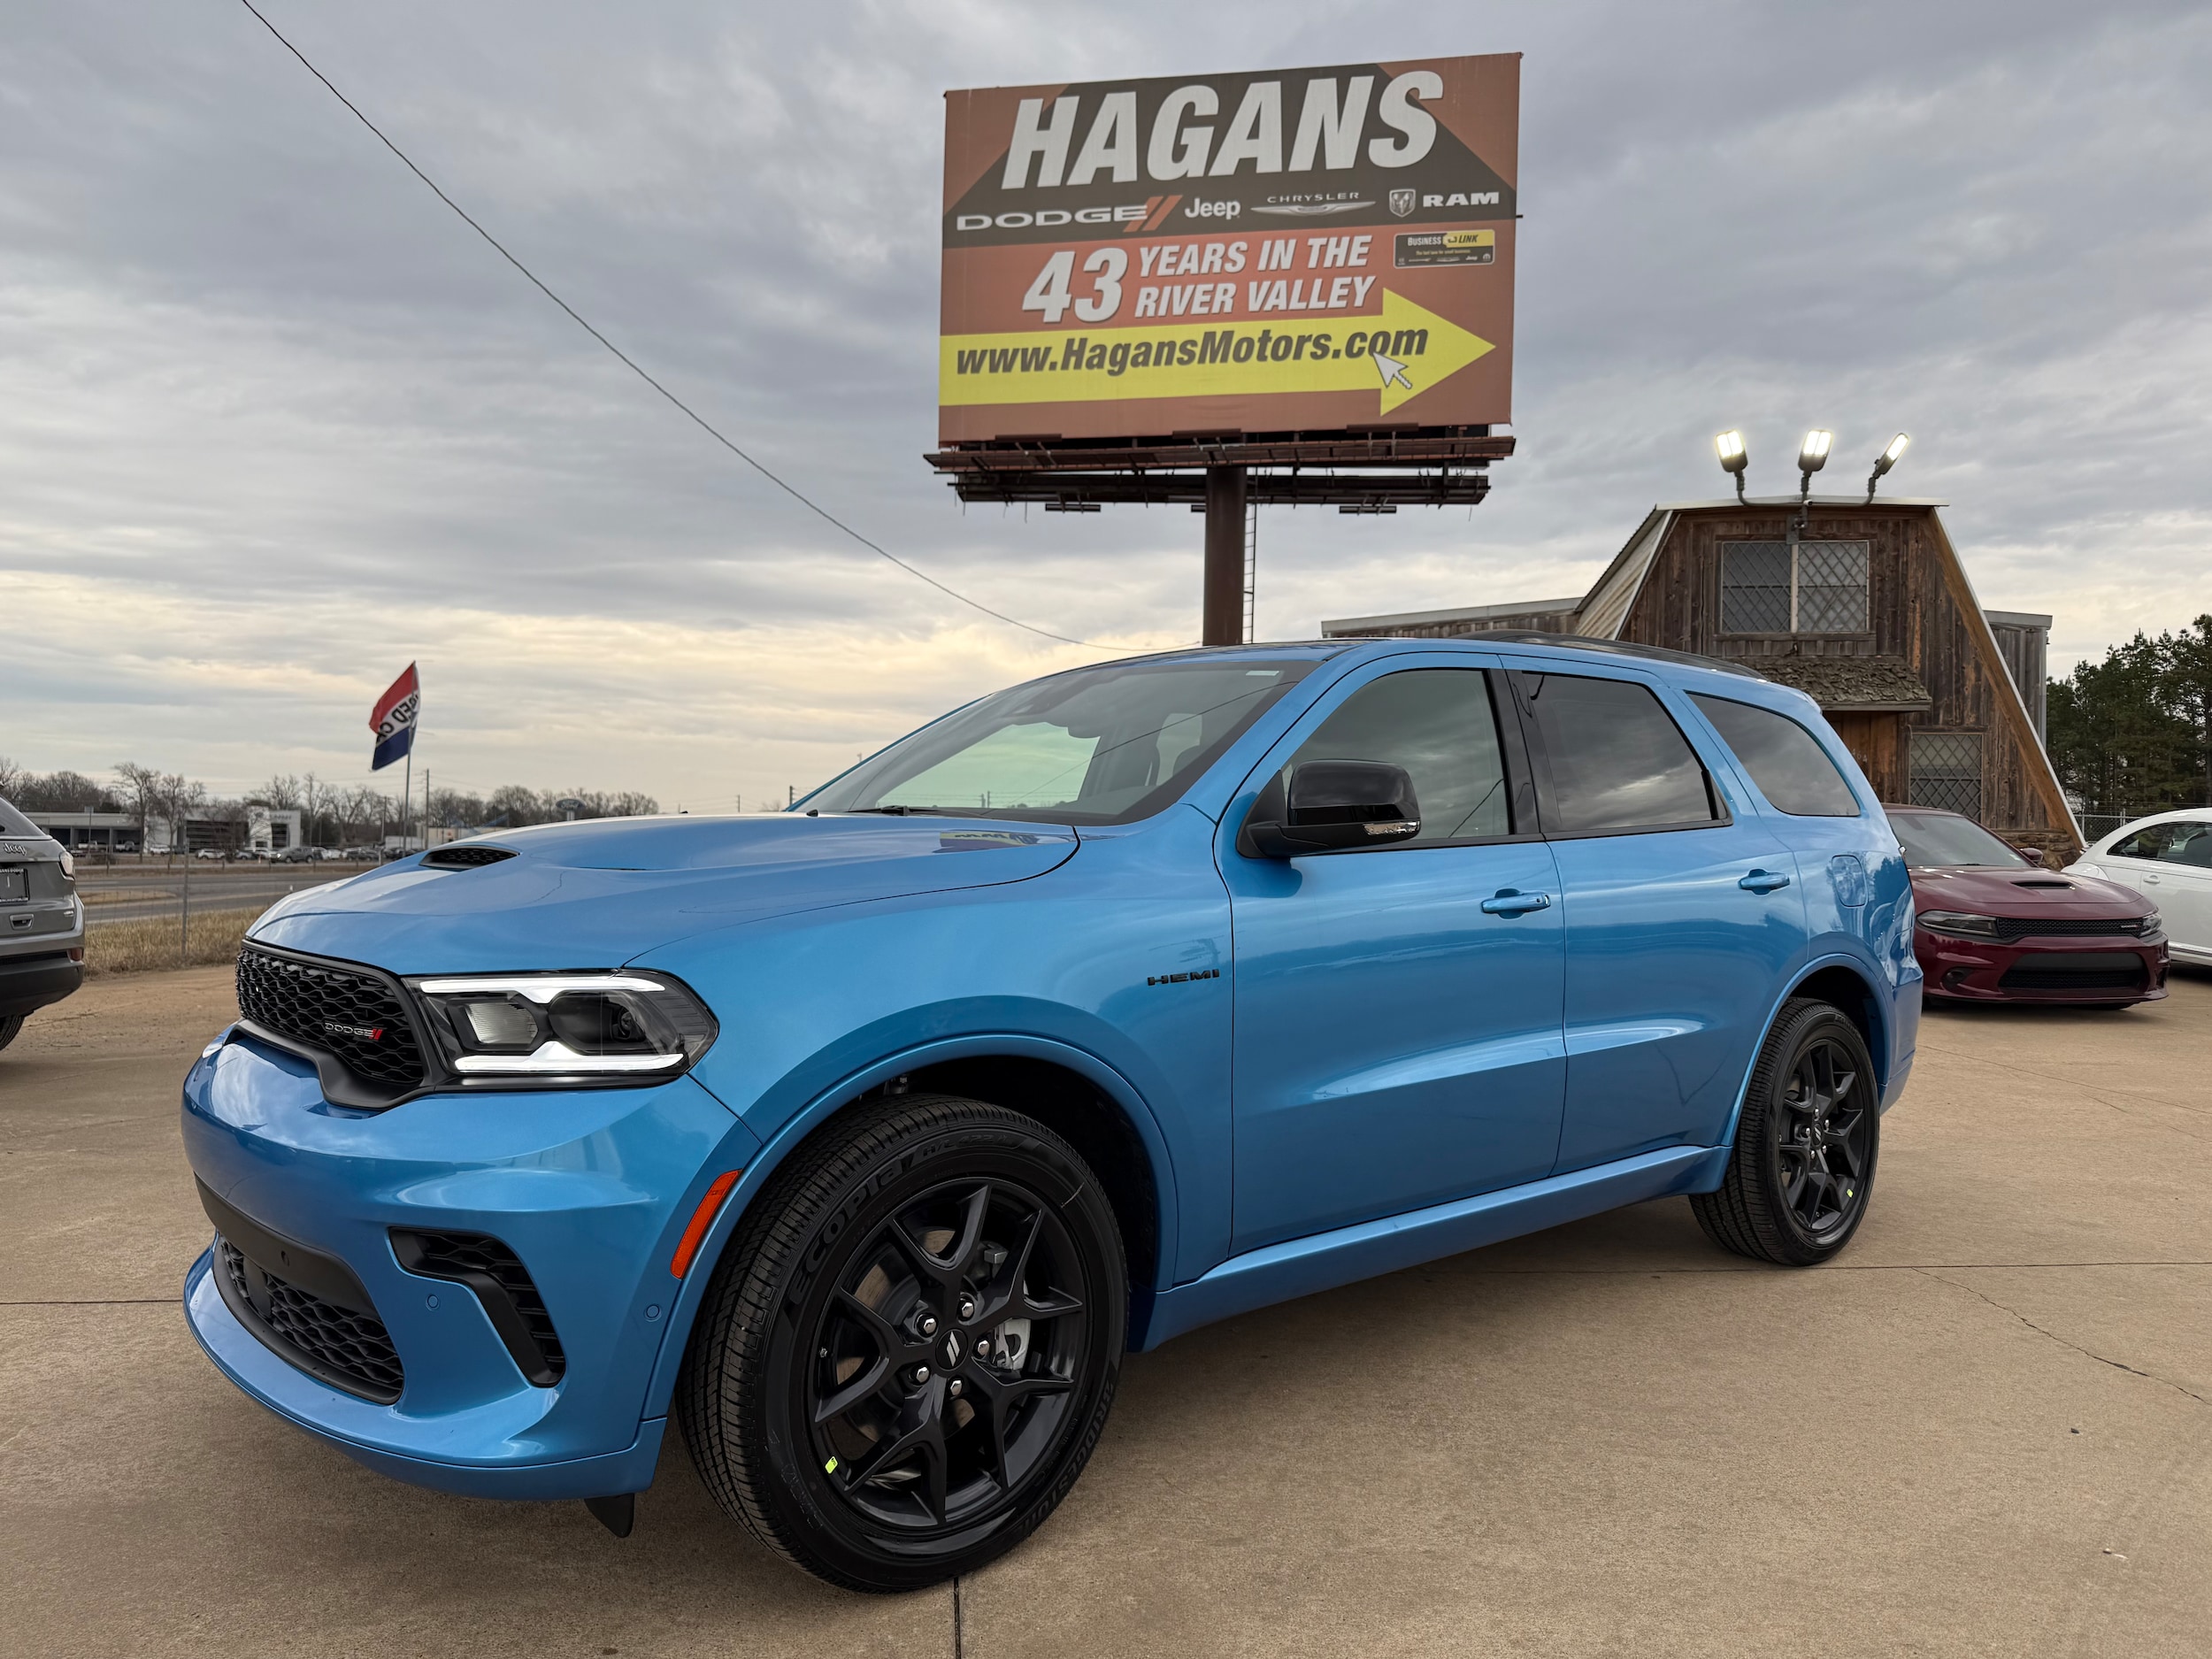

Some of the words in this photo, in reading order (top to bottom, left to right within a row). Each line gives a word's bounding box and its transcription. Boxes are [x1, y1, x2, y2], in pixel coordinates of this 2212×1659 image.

[1001, 70, 1444, 190] HAGANS
[1185, 197, 1240, 220] Jeep
[1267, 192, 1360, 204] CHRYSLER
[1423, 191, 1500, 208] RAM
[956, 204, 1148, 231] DODGE
[1407, 236, 1441, 247] BUSINESS
[1458, 234, 1479, 244] LINK
[1140, 241, 1248, 278] YEARS
[1256, 238, 1297, 272] IN
[1307, 234, 1373, 269] THE
[1022, 247, 1129, 324] 43
[1133, 282, 1238, 319] RIVER
[1248, 275, 1377, 312] VALLEY
[956, 328, 1429, 377] www.HagansMotors.com
[1147, 968, 1220, 987] HEMI
[324, 1022, 374, 1038] DODGE
